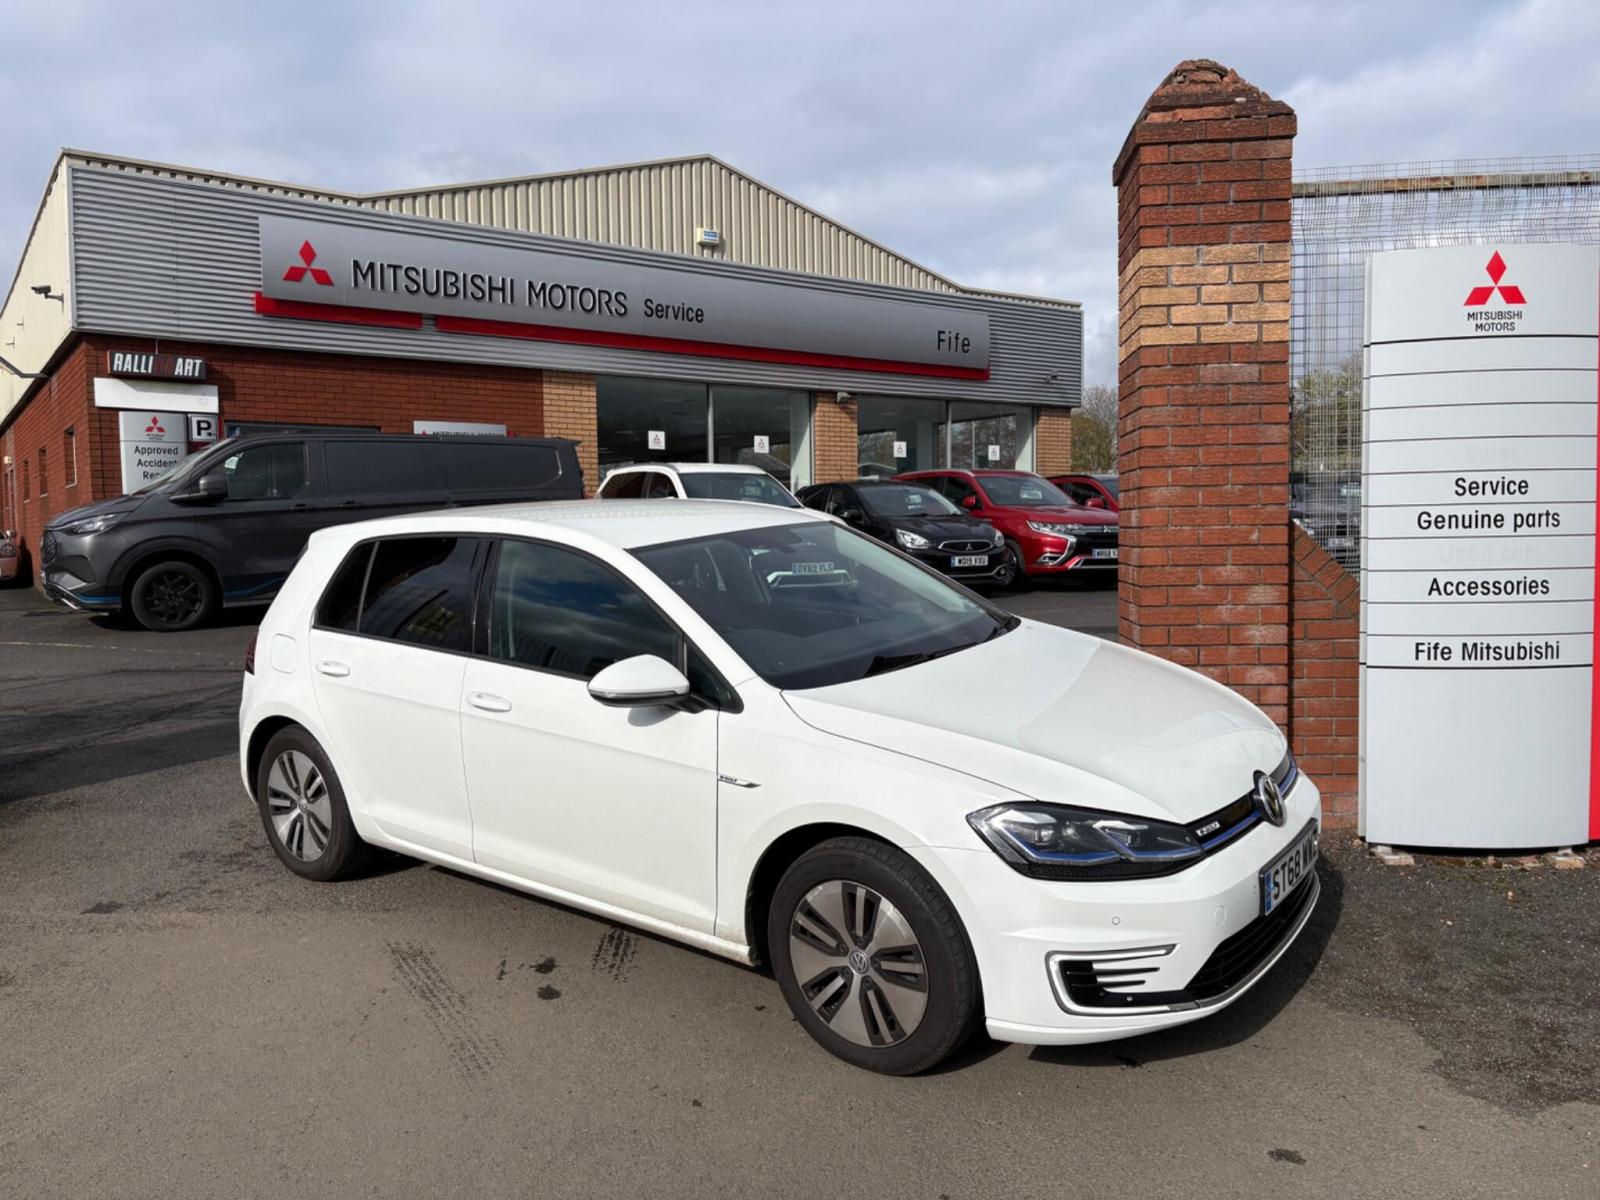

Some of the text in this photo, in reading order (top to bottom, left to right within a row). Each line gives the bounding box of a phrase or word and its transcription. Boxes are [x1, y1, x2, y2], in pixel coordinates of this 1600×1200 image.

[351, 259, 704, 323] MITSUBISHI MOTORS Service
[1467, 310, 1523, 321] MITSUBISHI
[1475, 321, 1516, 332] MOTORS
[937, 330, 970, 353] Fife
[134, 446, 178, 456] Approved
[1454, 476, 1529, 496] Service
[1417, 509, 1561, 532] Genuine parts
[1428, 576, 1550, 596] Accessories
[1414, 641, 1560, 661] Fife Mitsubishi
[1273, 849, 1300, 900] ST68
